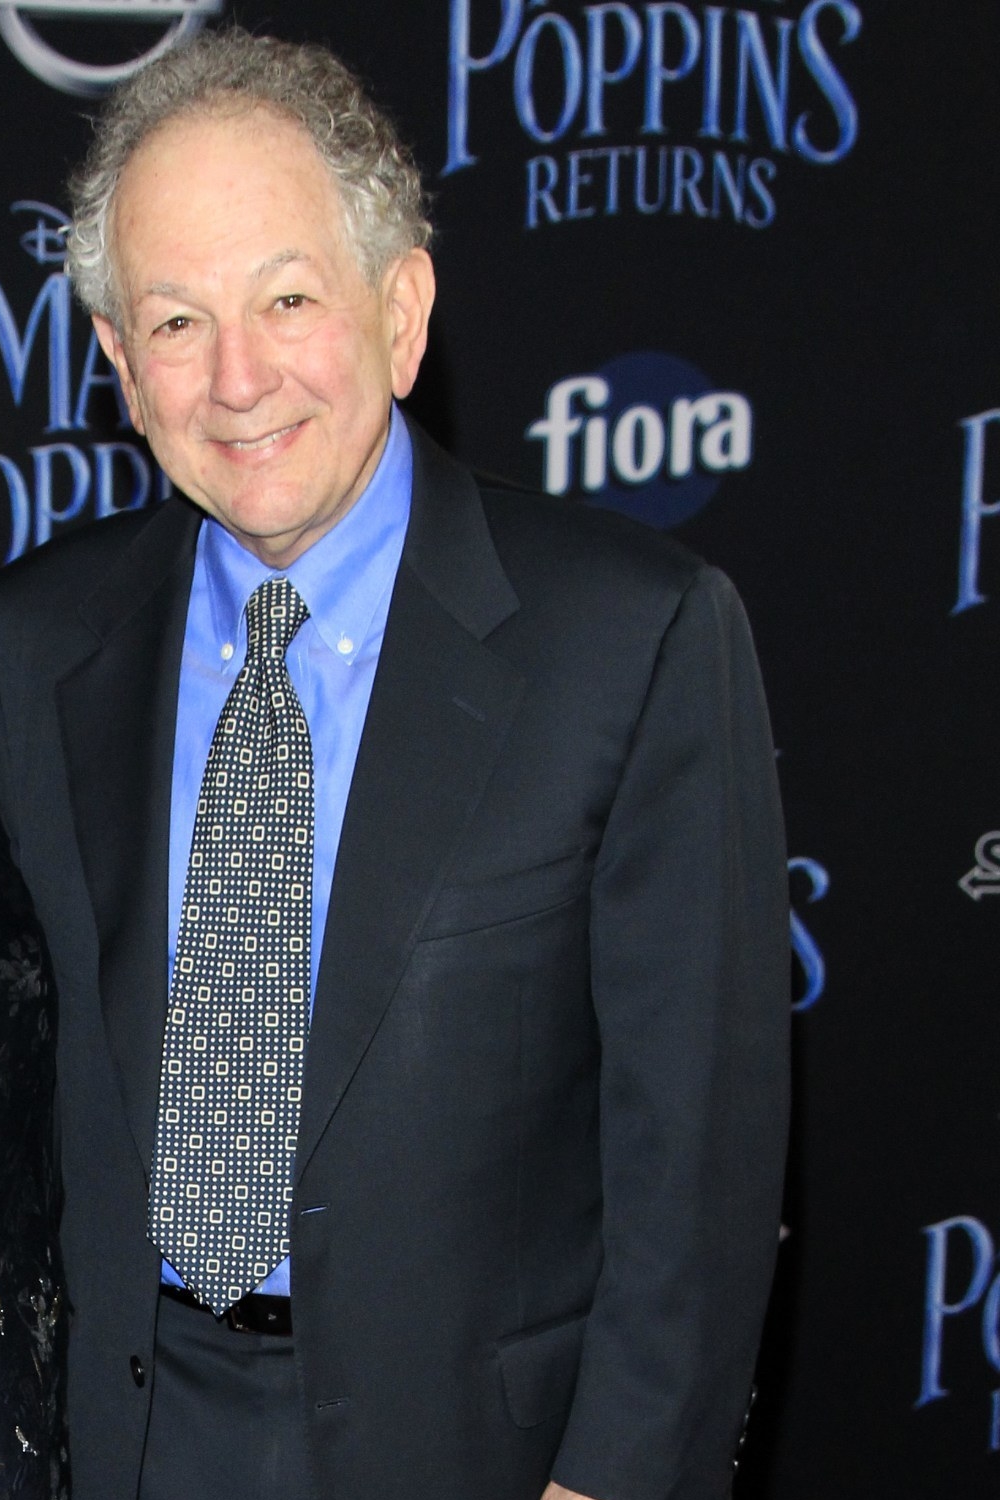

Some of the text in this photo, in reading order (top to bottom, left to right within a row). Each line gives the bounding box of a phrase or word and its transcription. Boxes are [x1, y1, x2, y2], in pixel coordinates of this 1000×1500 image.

[440, 0, 862, 177] POPPINS
[525, 144, 778, 230] RETURNS
[525, 374, 752, 496] fiora
